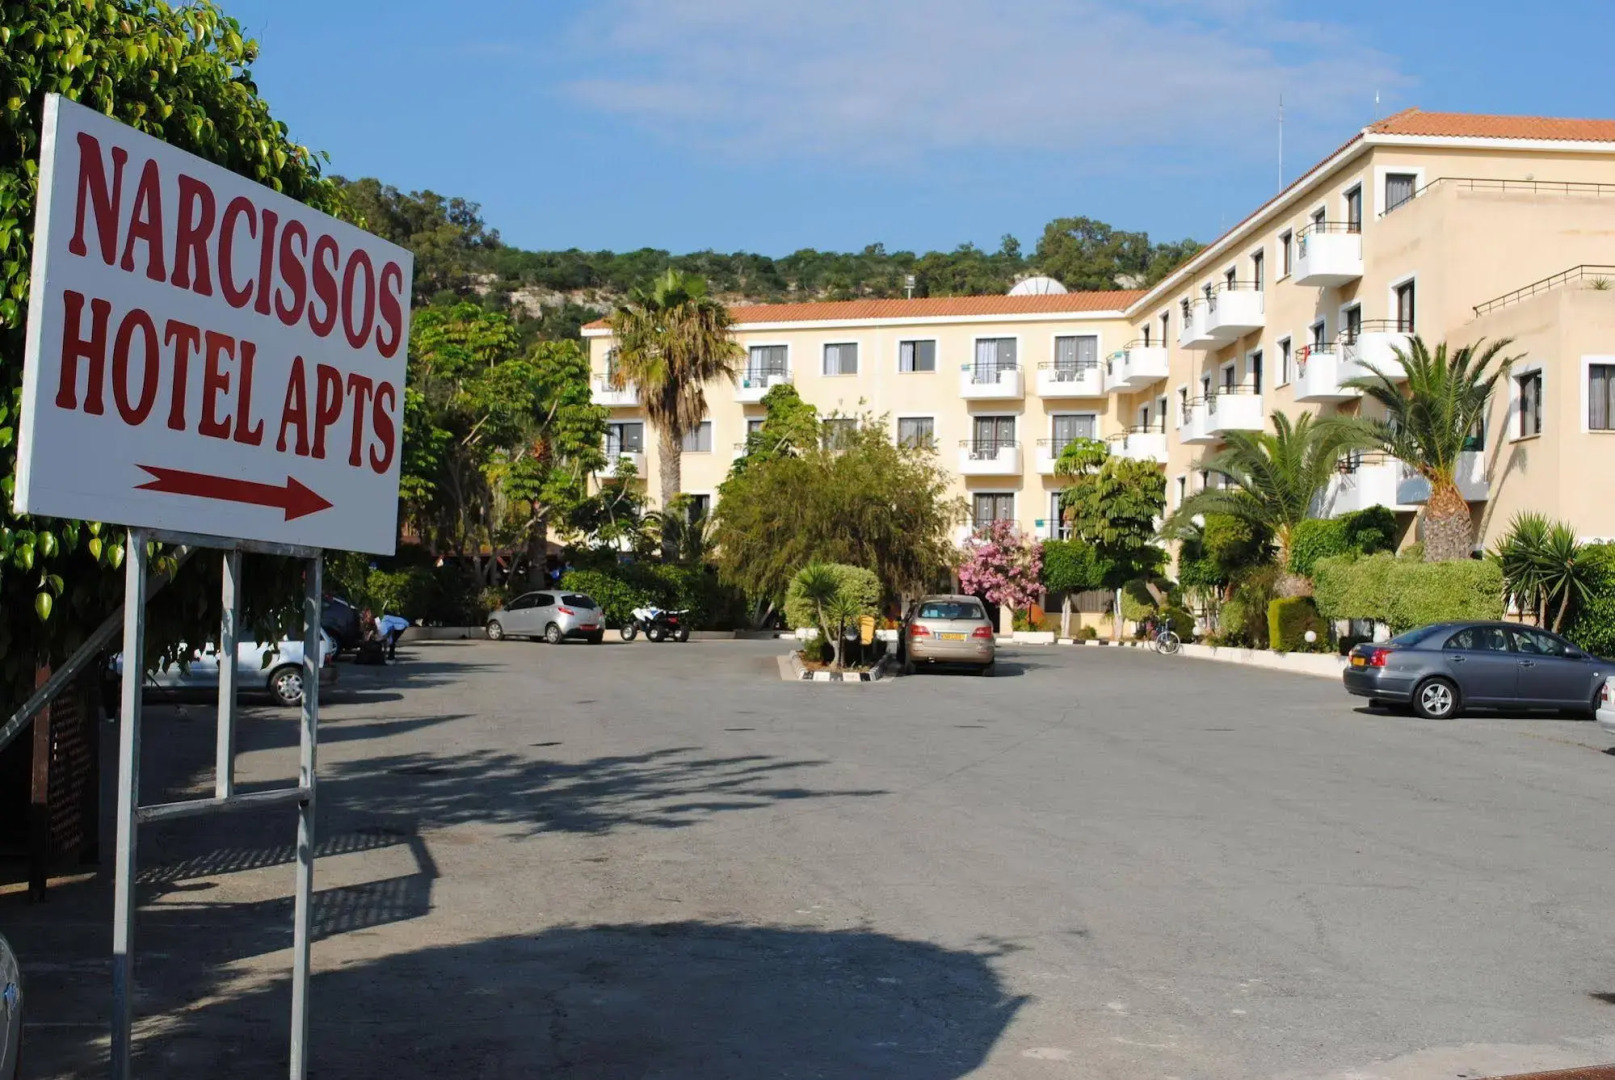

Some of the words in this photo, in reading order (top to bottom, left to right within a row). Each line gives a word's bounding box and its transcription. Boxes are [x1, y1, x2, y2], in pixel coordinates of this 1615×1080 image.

[69, 132, 403, 358] NARCISSOS
[55, 290, 264, 446] HOTEL
[276, 356, 396, 474] APTS
